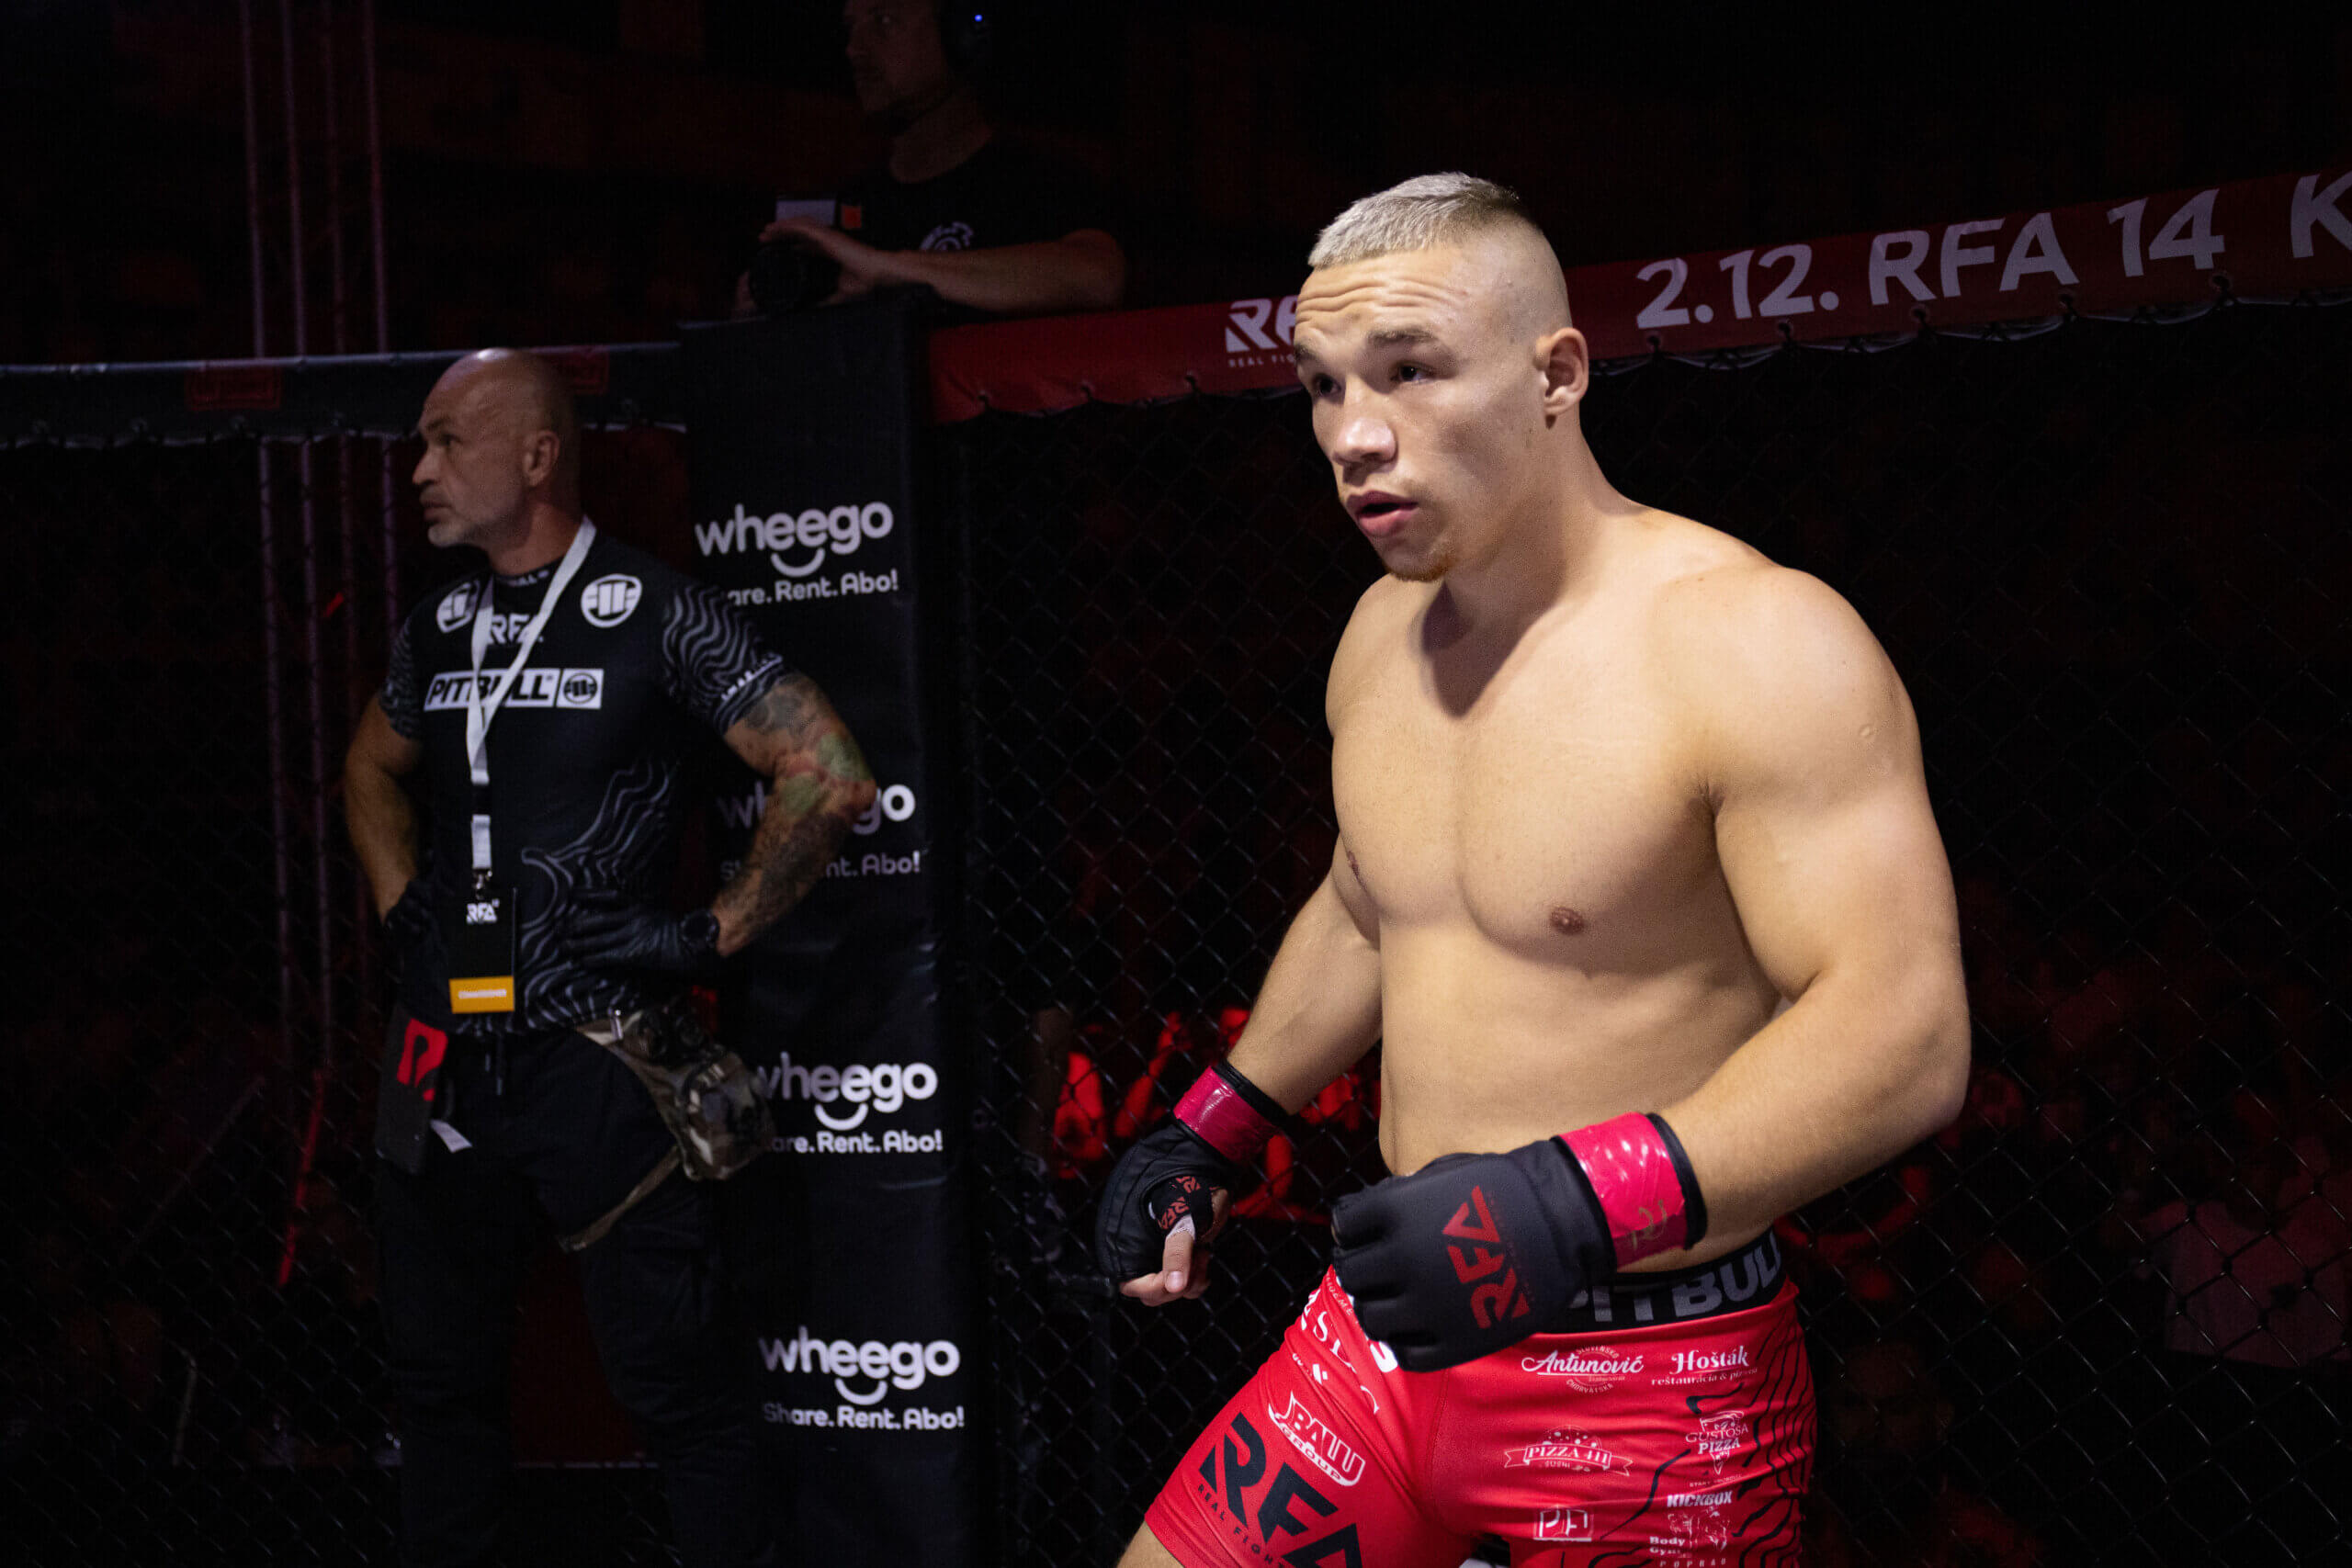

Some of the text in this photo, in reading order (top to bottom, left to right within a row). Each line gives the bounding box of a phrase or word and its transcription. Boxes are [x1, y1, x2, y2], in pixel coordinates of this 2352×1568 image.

[1636, 243, 1840, 330] 2.12.
[1868, 212, 2081, 306] RFA
[2107, 188, 2226, 277] 14
[1225, 295, 1297, 353] RF
[694, 500, 895, 557] wheego
[491, 613, 544, 645] RF
[756, 1050, 939, 1114] wheego
[1442, 1185, 1531, 1329] RFA
[758, 1324, 962, 1392] wheego
[1521, 1349, 1645, 1374] Antunović
[1685, 1423, 1748, 1443] GUSTOSA
[1698, 1437, 1741, 1455] PIZZA
[1528, 1446, 1579, 1459] PIZZA
[1666, 1491, 1733, 1508] KICKBOX
[1649, 1536, 1686, 1547] Body
